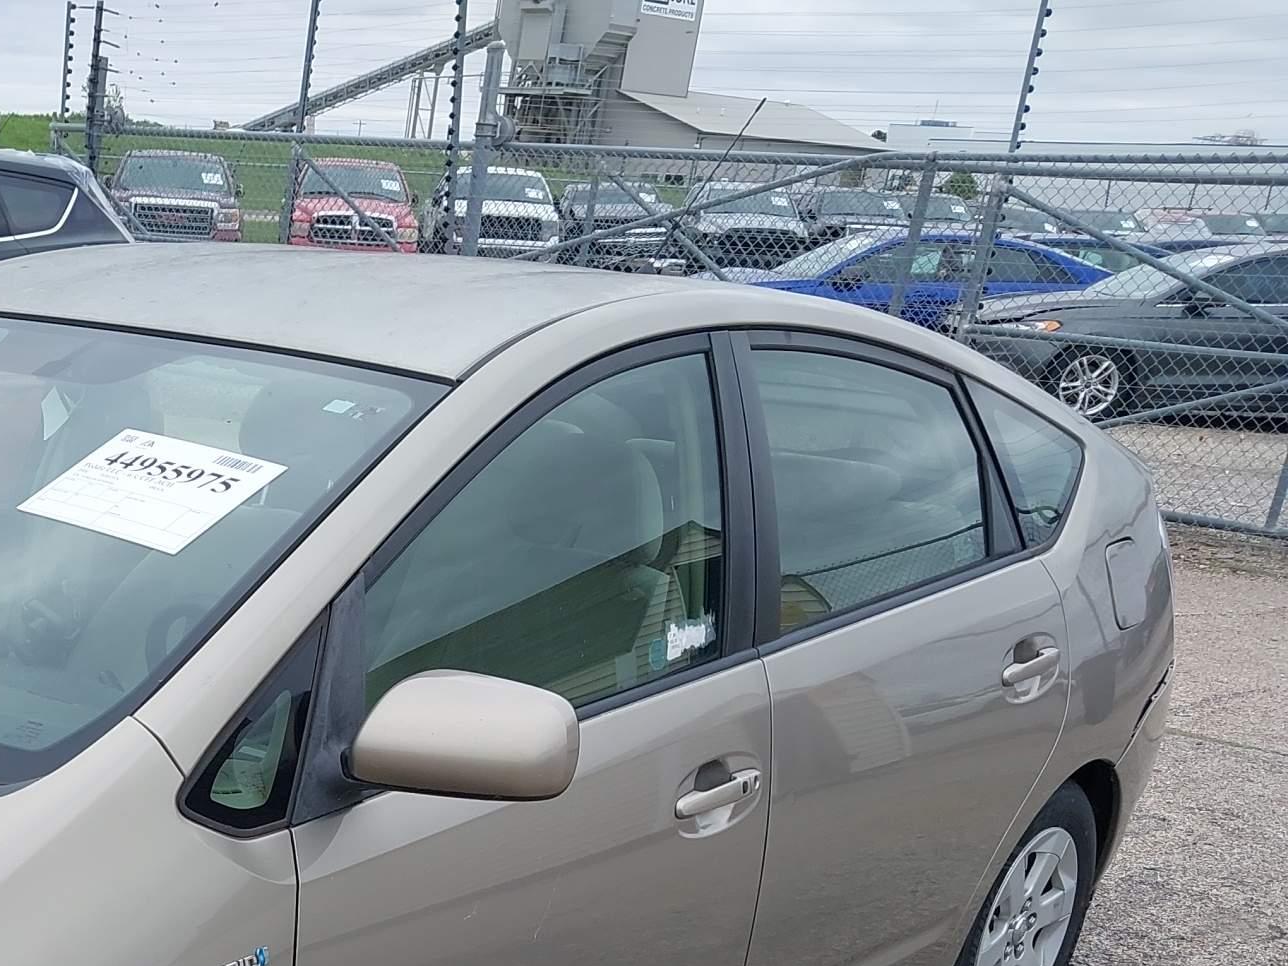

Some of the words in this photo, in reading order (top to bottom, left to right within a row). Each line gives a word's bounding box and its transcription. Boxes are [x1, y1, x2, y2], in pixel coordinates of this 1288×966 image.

[642, 4, 668, 15] CONCRETE
[668, 7, 694, 19] PRODUCTS
[104, 450, 241, 494] 44955975
